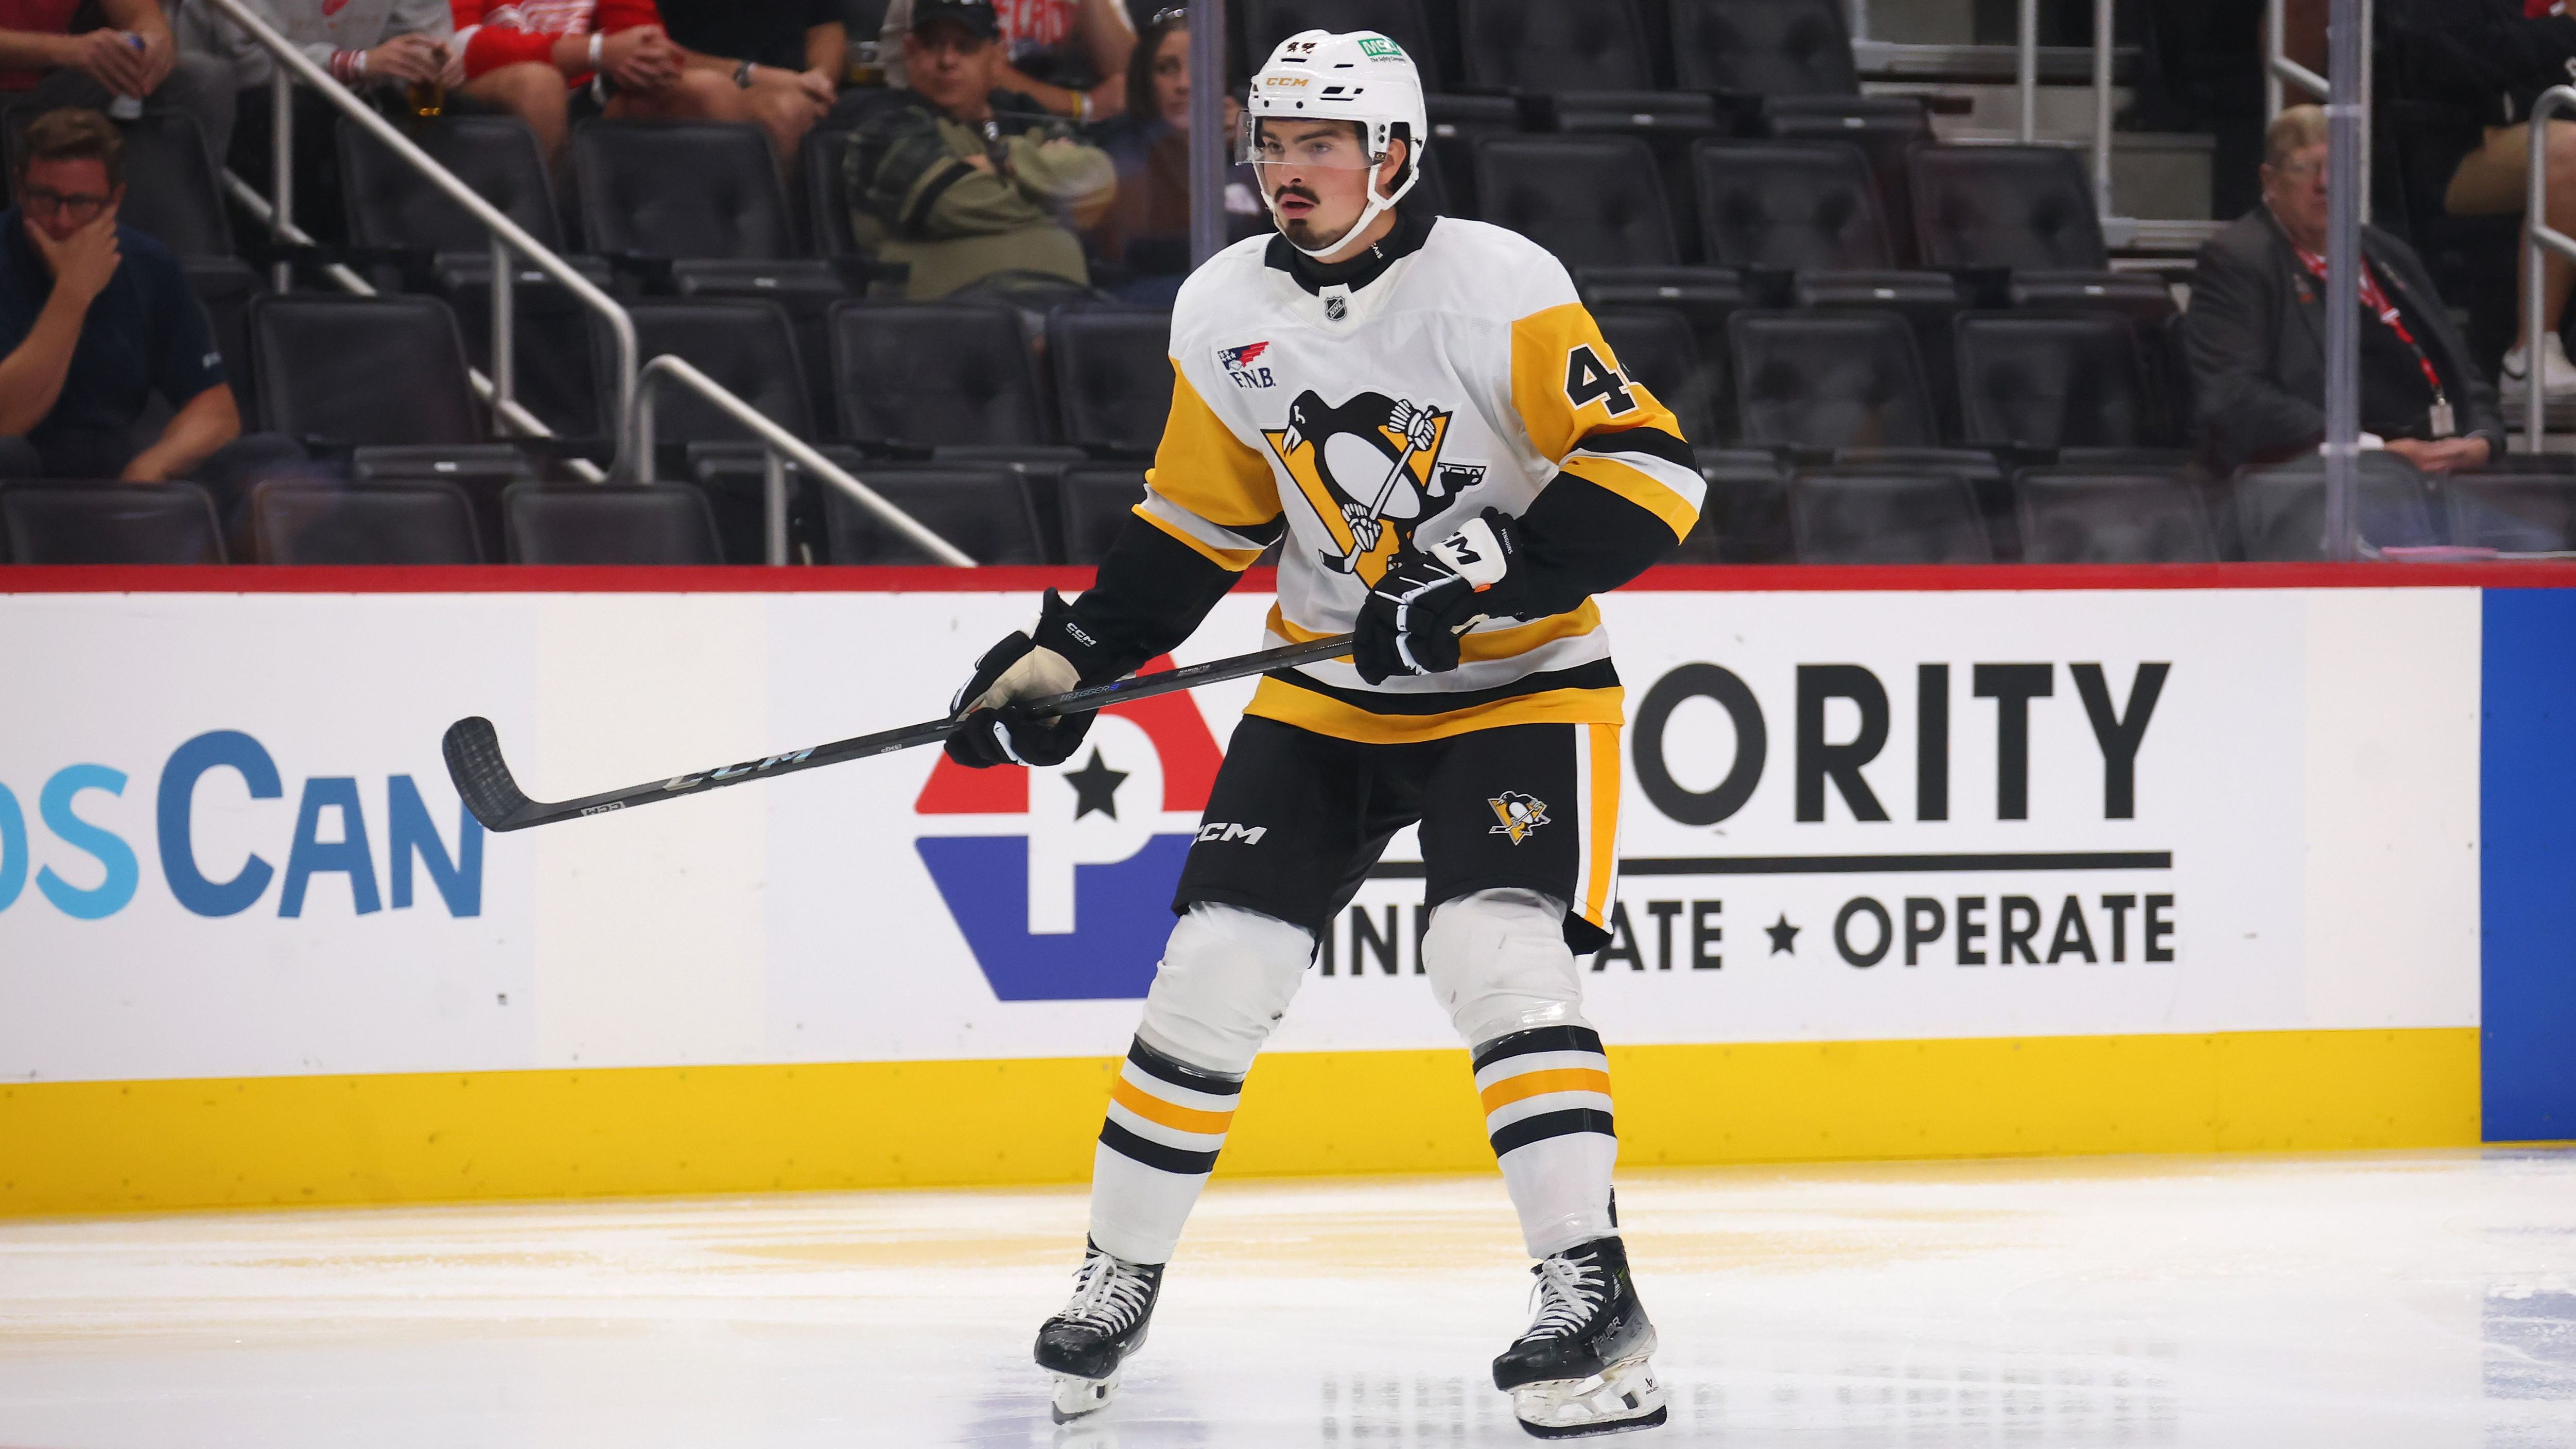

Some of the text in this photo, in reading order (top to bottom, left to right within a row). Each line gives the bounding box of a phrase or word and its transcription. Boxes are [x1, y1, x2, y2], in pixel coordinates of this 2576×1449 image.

[1266, 77, 1310, 86] CCM
[1329, 301, 1343, 317] NHL
[1563, 343, 1643, 419] 4
[1501, 528, 1513, 554] PENGUINS
[1067, 622, 1097, 645] CCM
[1632, 661, 2174, 827] ORITY
[1834, 893, 2175, 969] OPERATE
